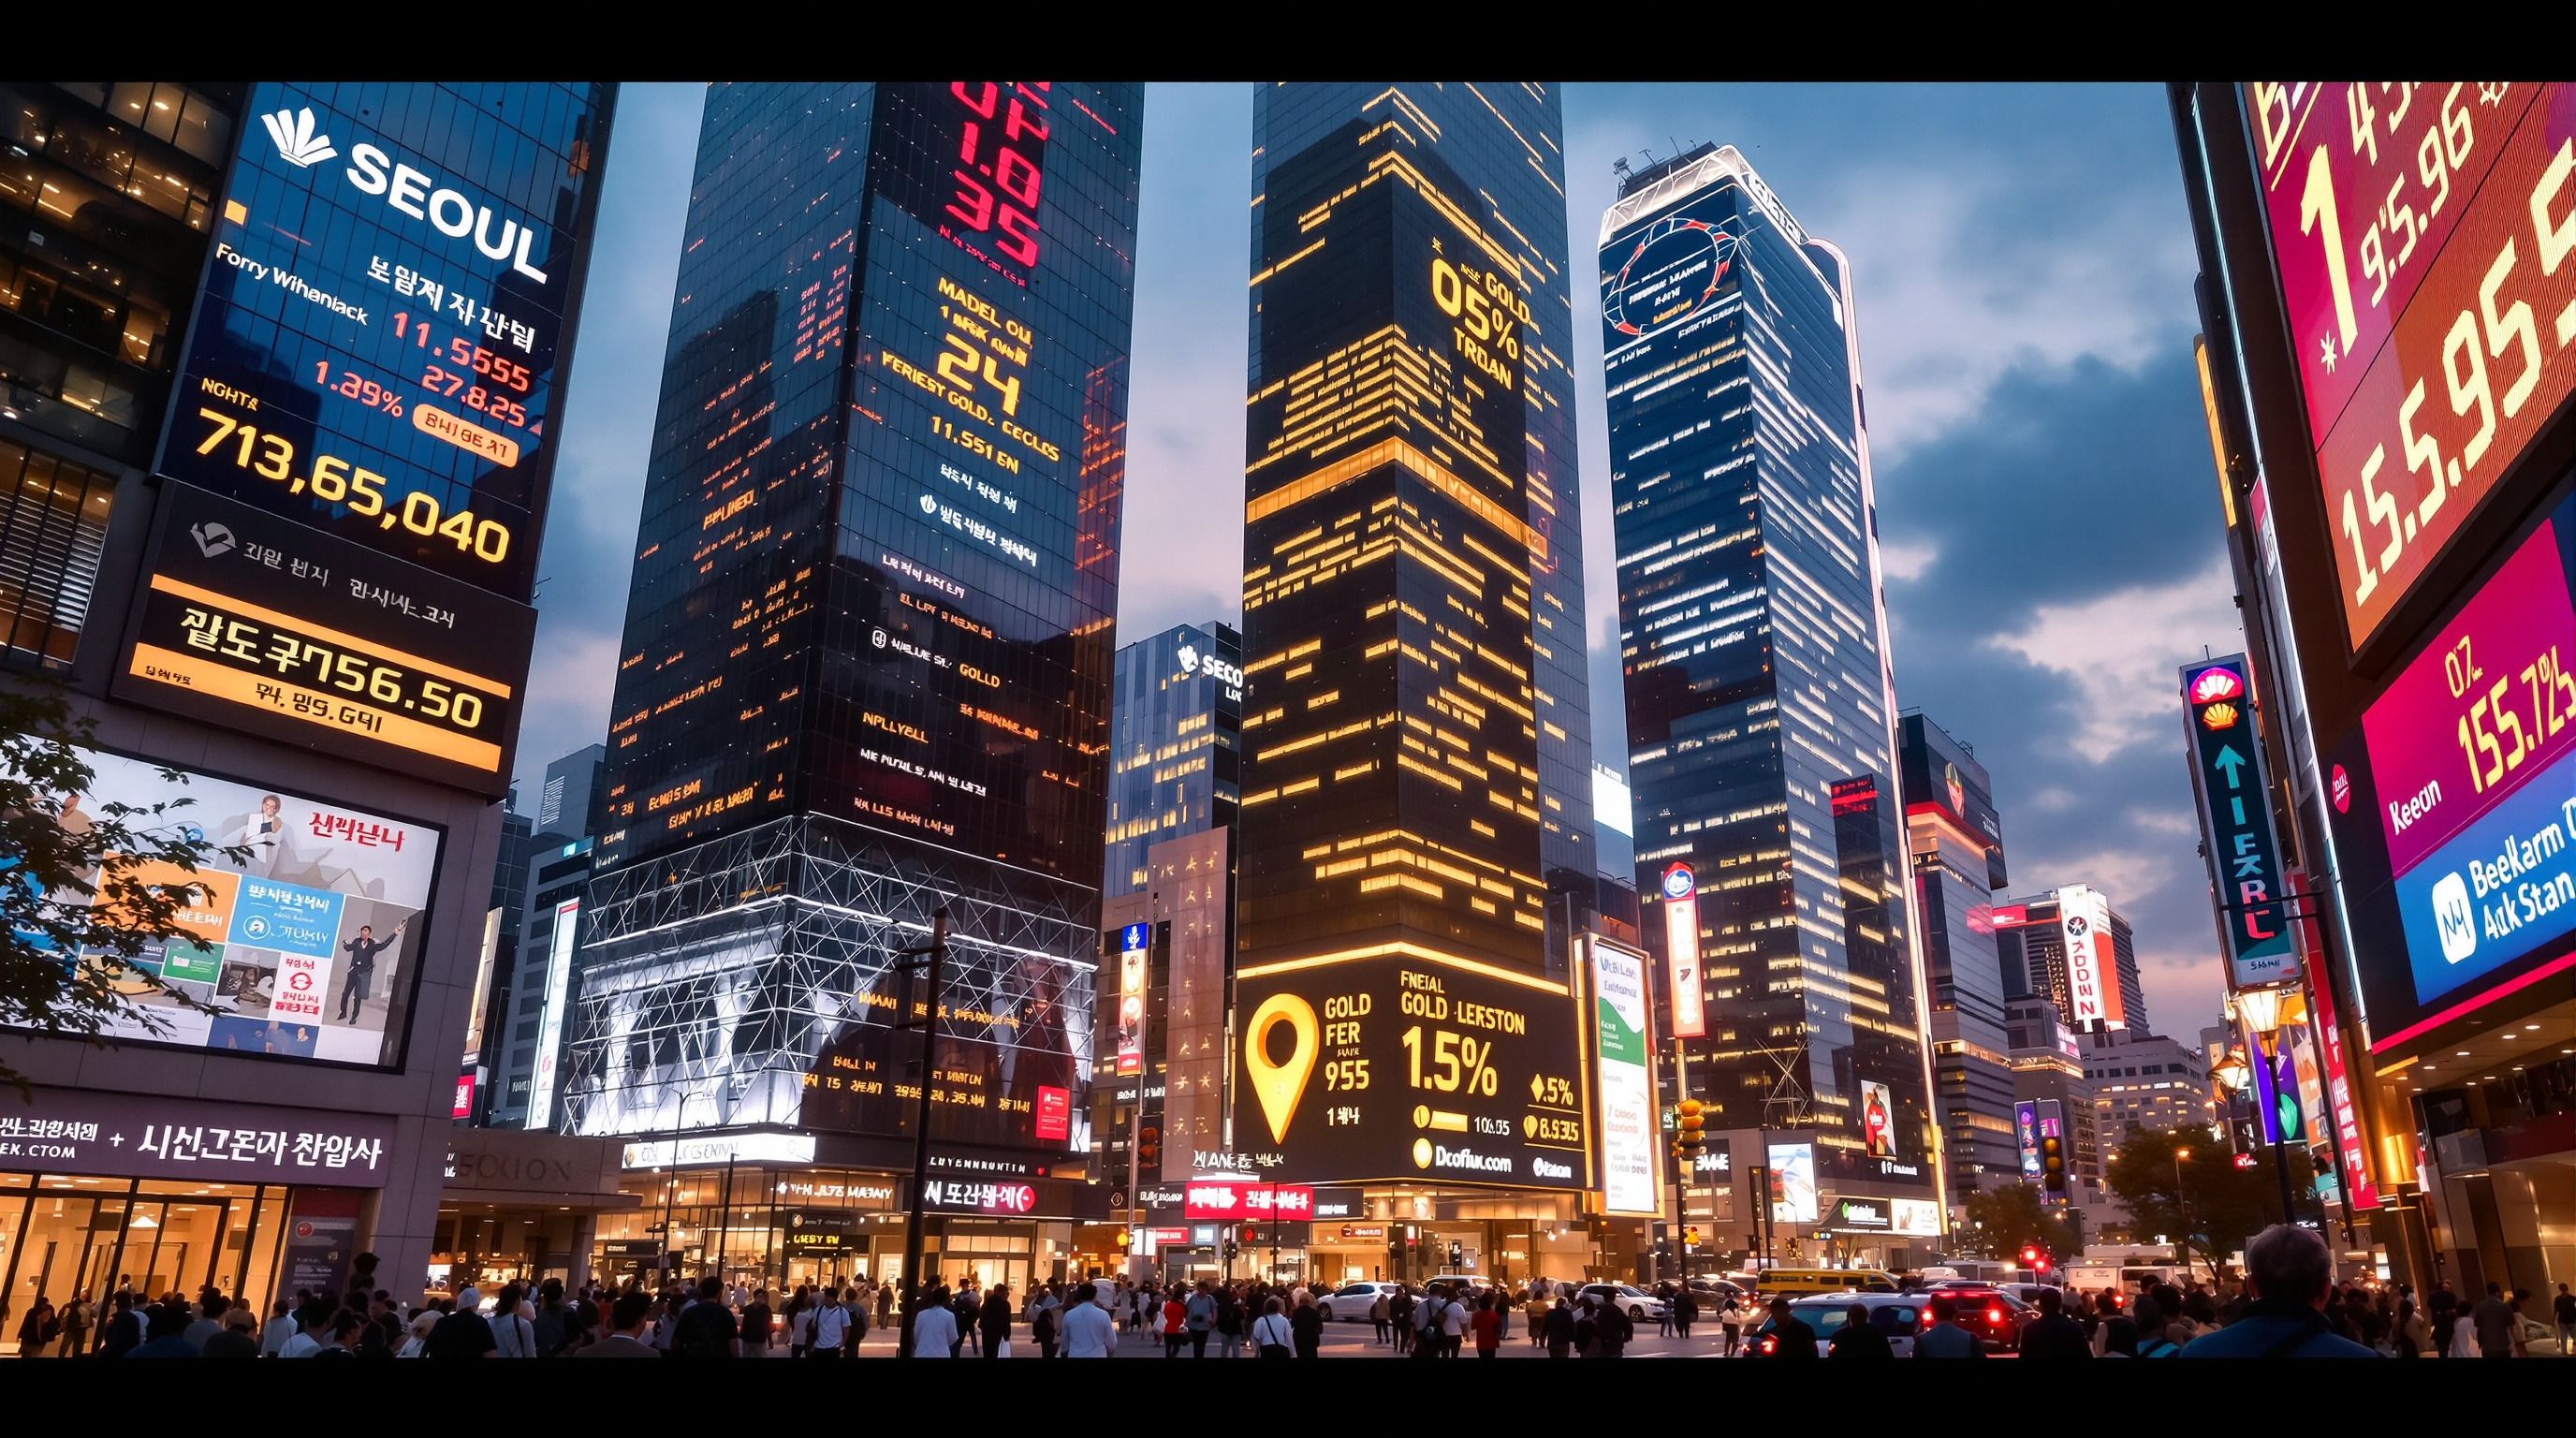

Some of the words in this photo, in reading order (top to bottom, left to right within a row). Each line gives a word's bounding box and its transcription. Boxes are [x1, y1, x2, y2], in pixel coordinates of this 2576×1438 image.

[345, 142, 548, 285] SEOUL
[215, 242, 269, 280] Forry
[1486, 271, 1530, 324] GOLD
[937, 332, 1020, 417] 24
[196, 407, 510, 564] 713,65,040
[1202, 654, 1243, 688] SECO
[1325, 993, 1371, 1020] GOLD
[1401, 991, 1448, 1020] GOLD
[1325, 1021, 1360, 1046] FER
[1402, 1025, 1498, 1097] 1.5%
